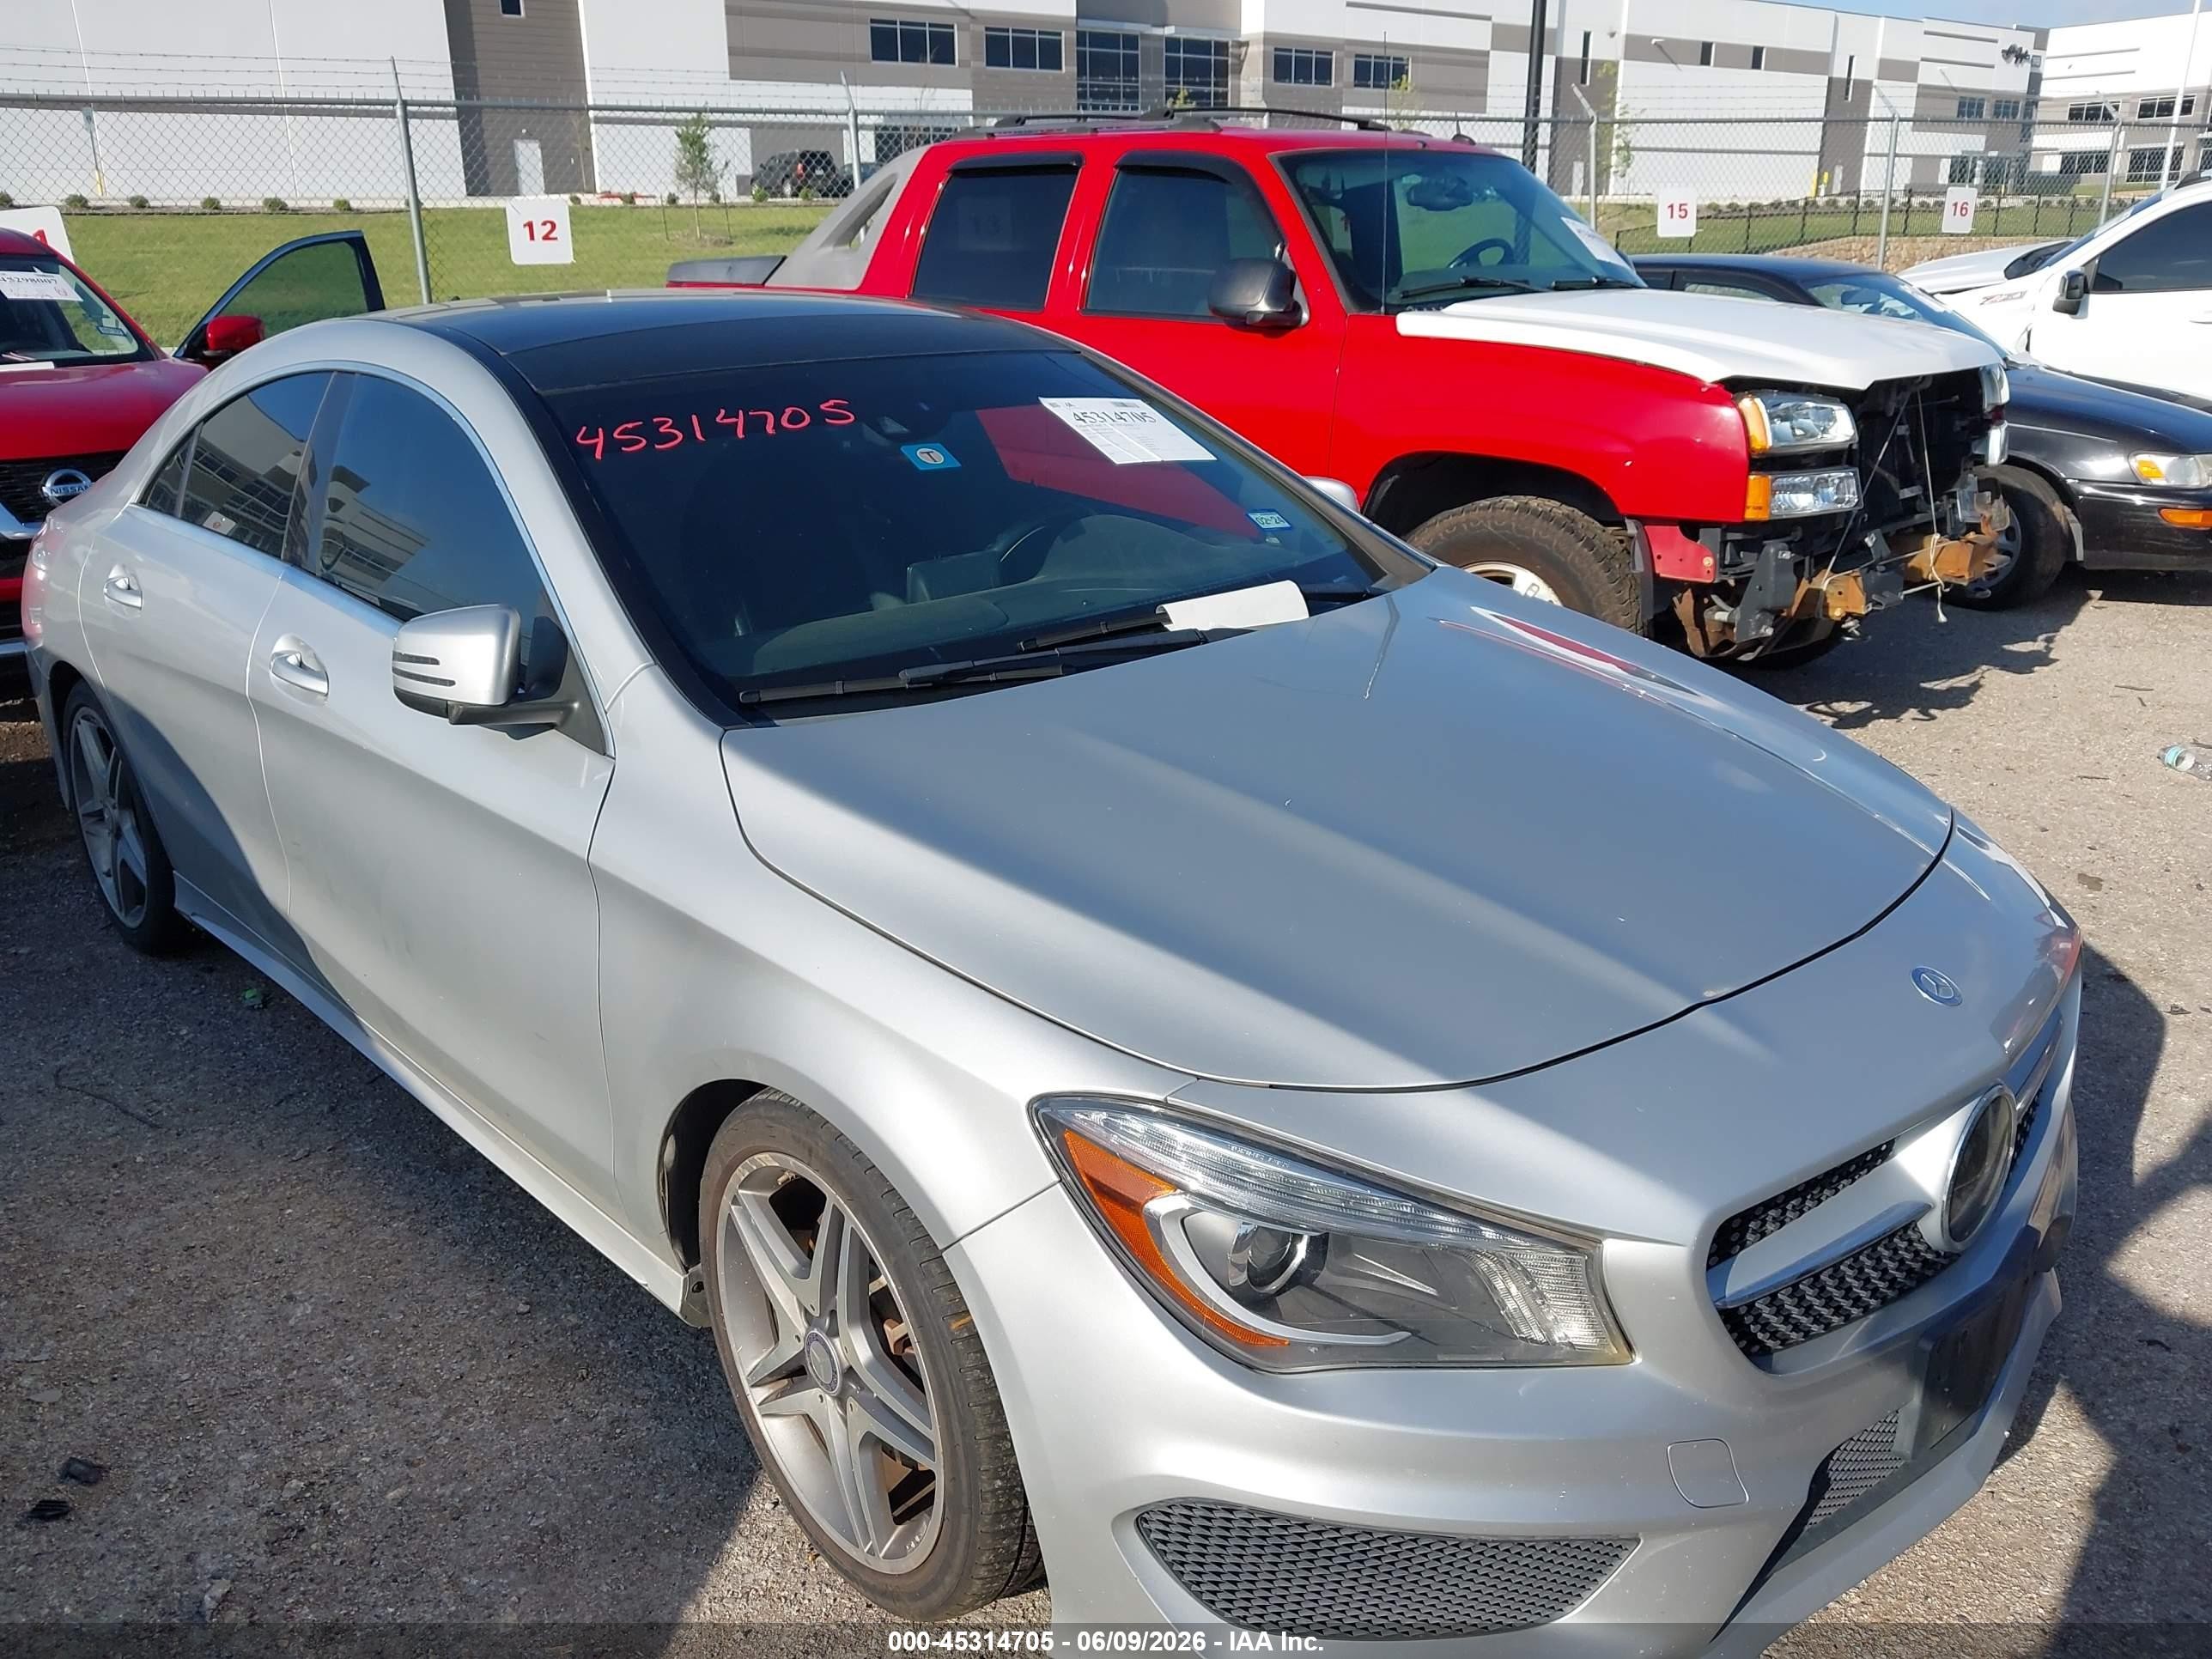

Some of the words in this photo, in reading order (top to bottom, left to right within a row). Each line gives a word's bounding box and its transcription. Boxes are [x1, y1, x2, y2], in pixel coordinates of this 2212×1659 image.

[1668, 203, 1688, 219] 15
[1952, 201, 1969, 217] 16
[522, 220, 558, 241] 12
[1073, 411, 1157, 424] 45314705
[576, 399, 856, 459] 45314705
